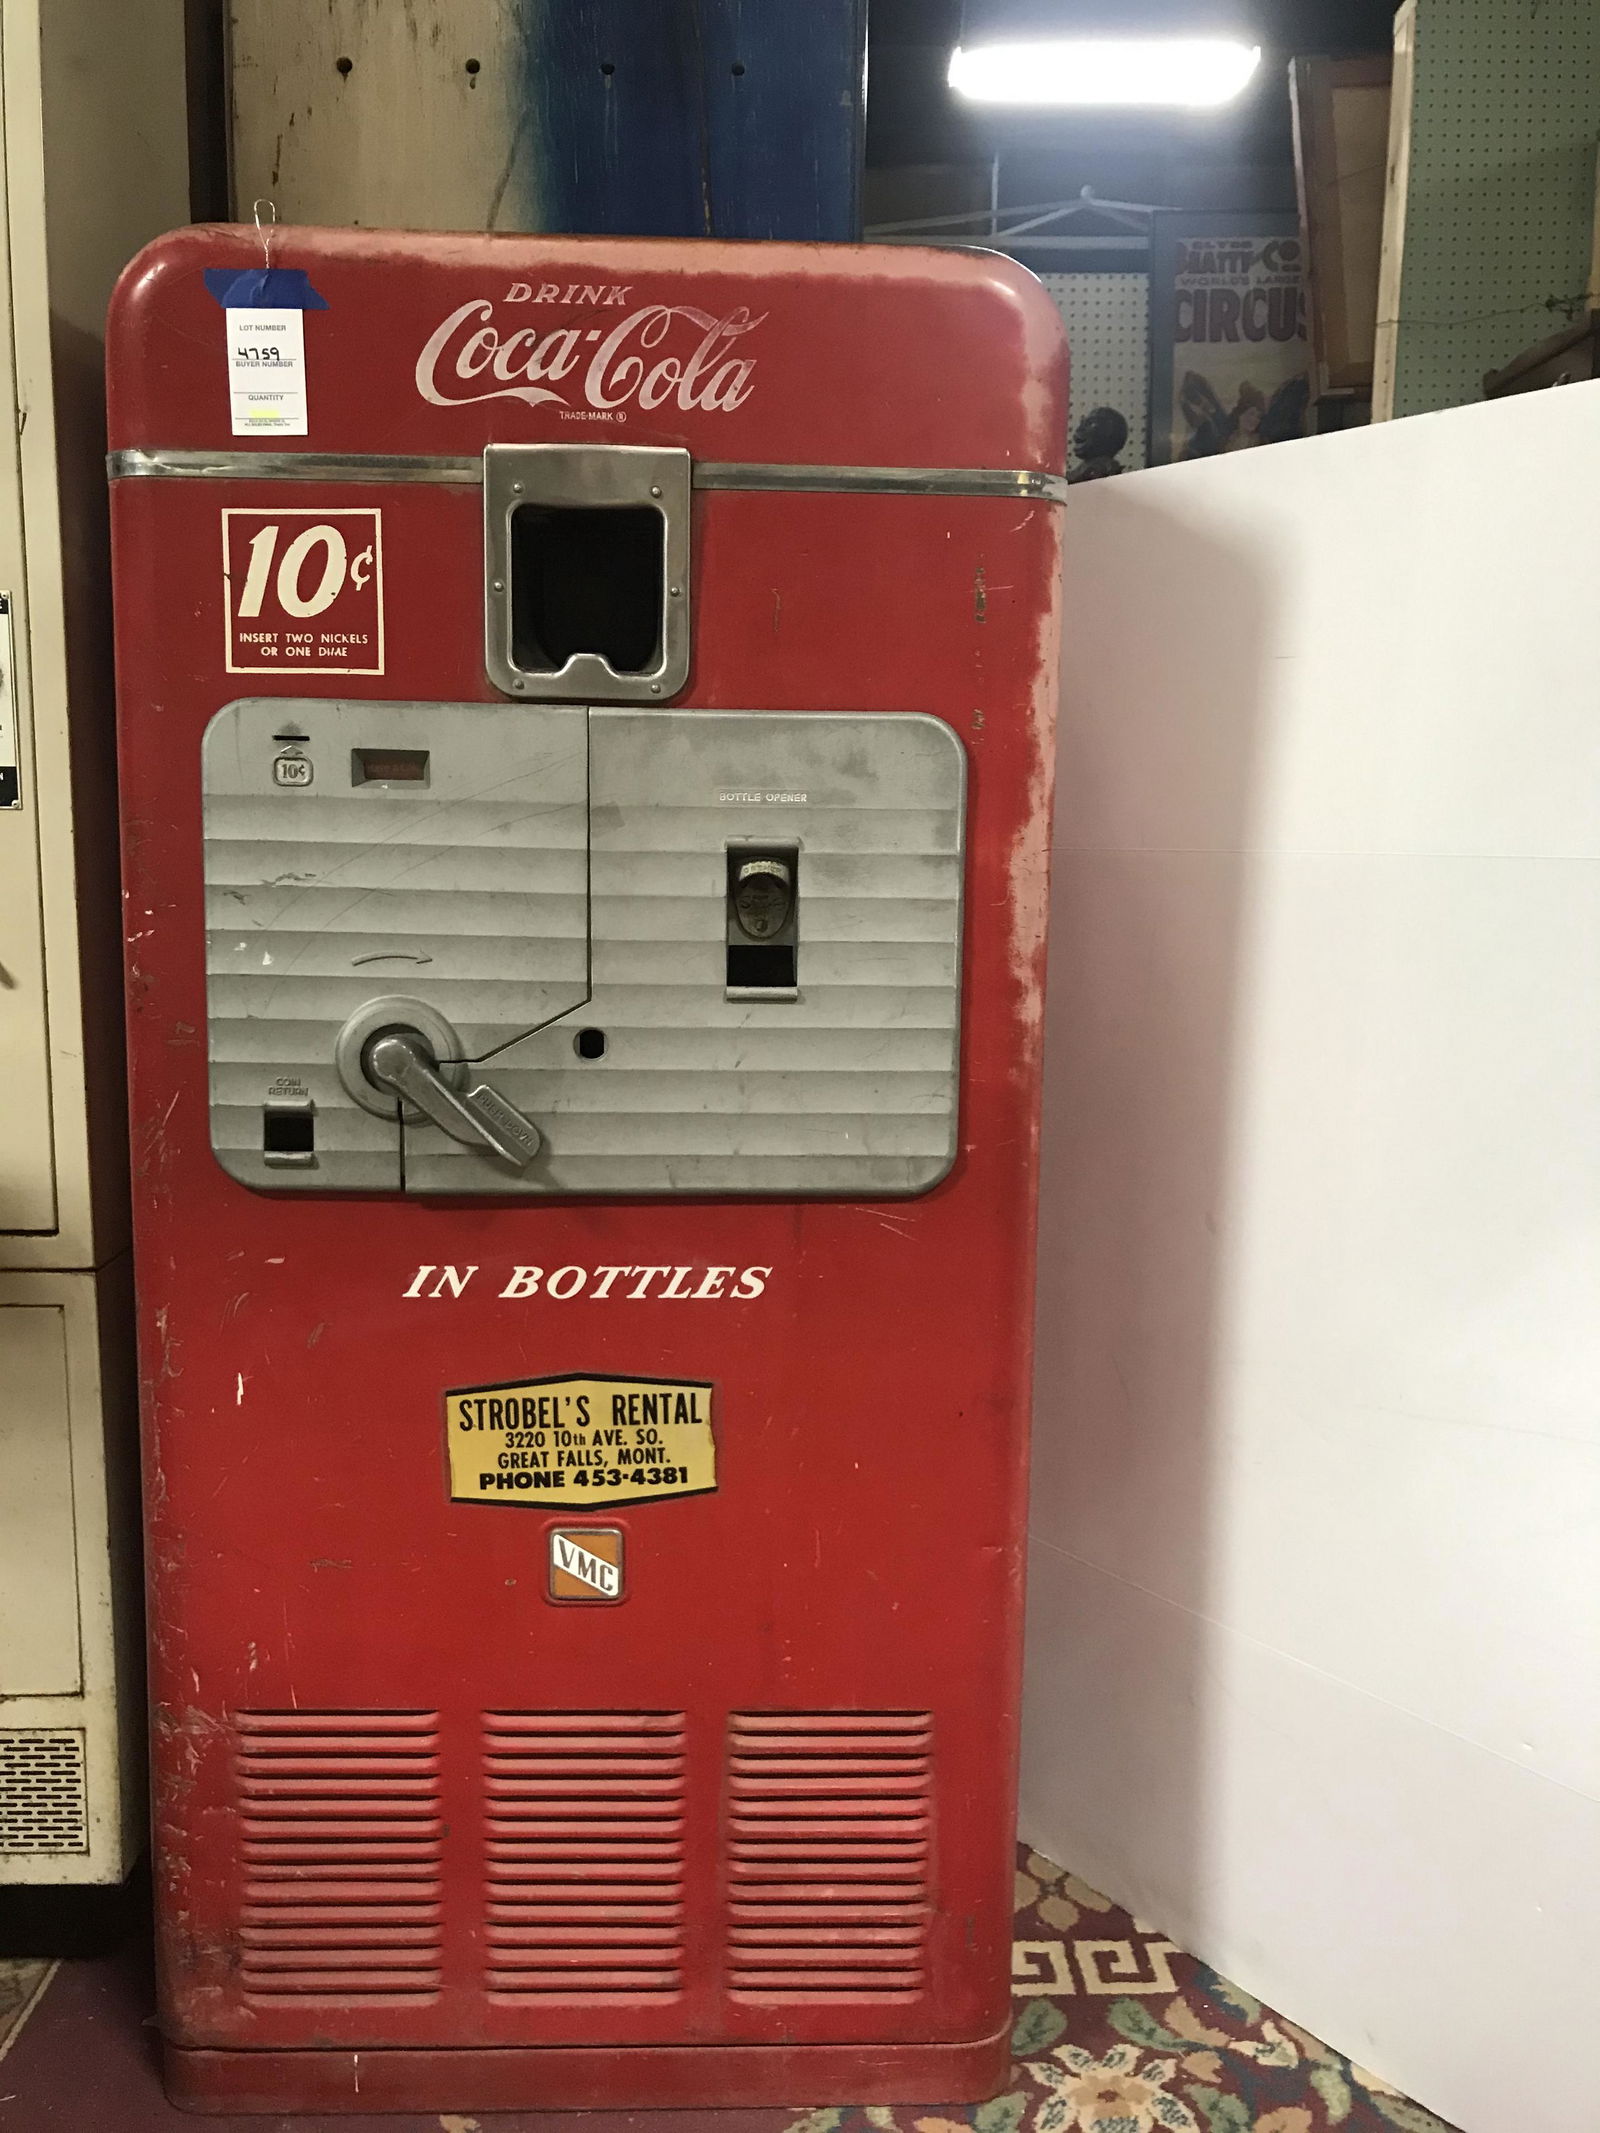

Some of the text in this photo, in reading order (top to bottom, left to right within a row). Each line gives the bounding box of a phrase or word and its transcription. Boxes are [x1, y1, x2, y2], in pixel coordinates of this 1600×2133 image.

[503, 282, 633, 306] DRINK
[238, 347, 280, 361] 4759
[415, 299, 769, 412] Coca-Cola
[237, 524, 374, 619] 10¢
[239, 633, 368, 644] INSERT TWO NICKELS
[261, 647, 348, 657] OR ONE DIME
[281, 763, 305, 778] 10¢
[719, 792, 807, 802] BOTTLE OPENER
[268, 1087, 309, 1096] RETURN
[276, 1078, 301, 1086] COIN
[402, 1265, 774, 1299] IN BOTTLES
[459, 1392, 703, 1431] STROBEL'S RENTAL
[505, 1428, 664, 1448] 3220 10th AVE. SO.
[497, 1447, 671, 1469] GREAT FALLS, MONT.
[479, 1467, 689, 1490] PHONE 453-4381
[558, 1538, 613, 1591] VMC
